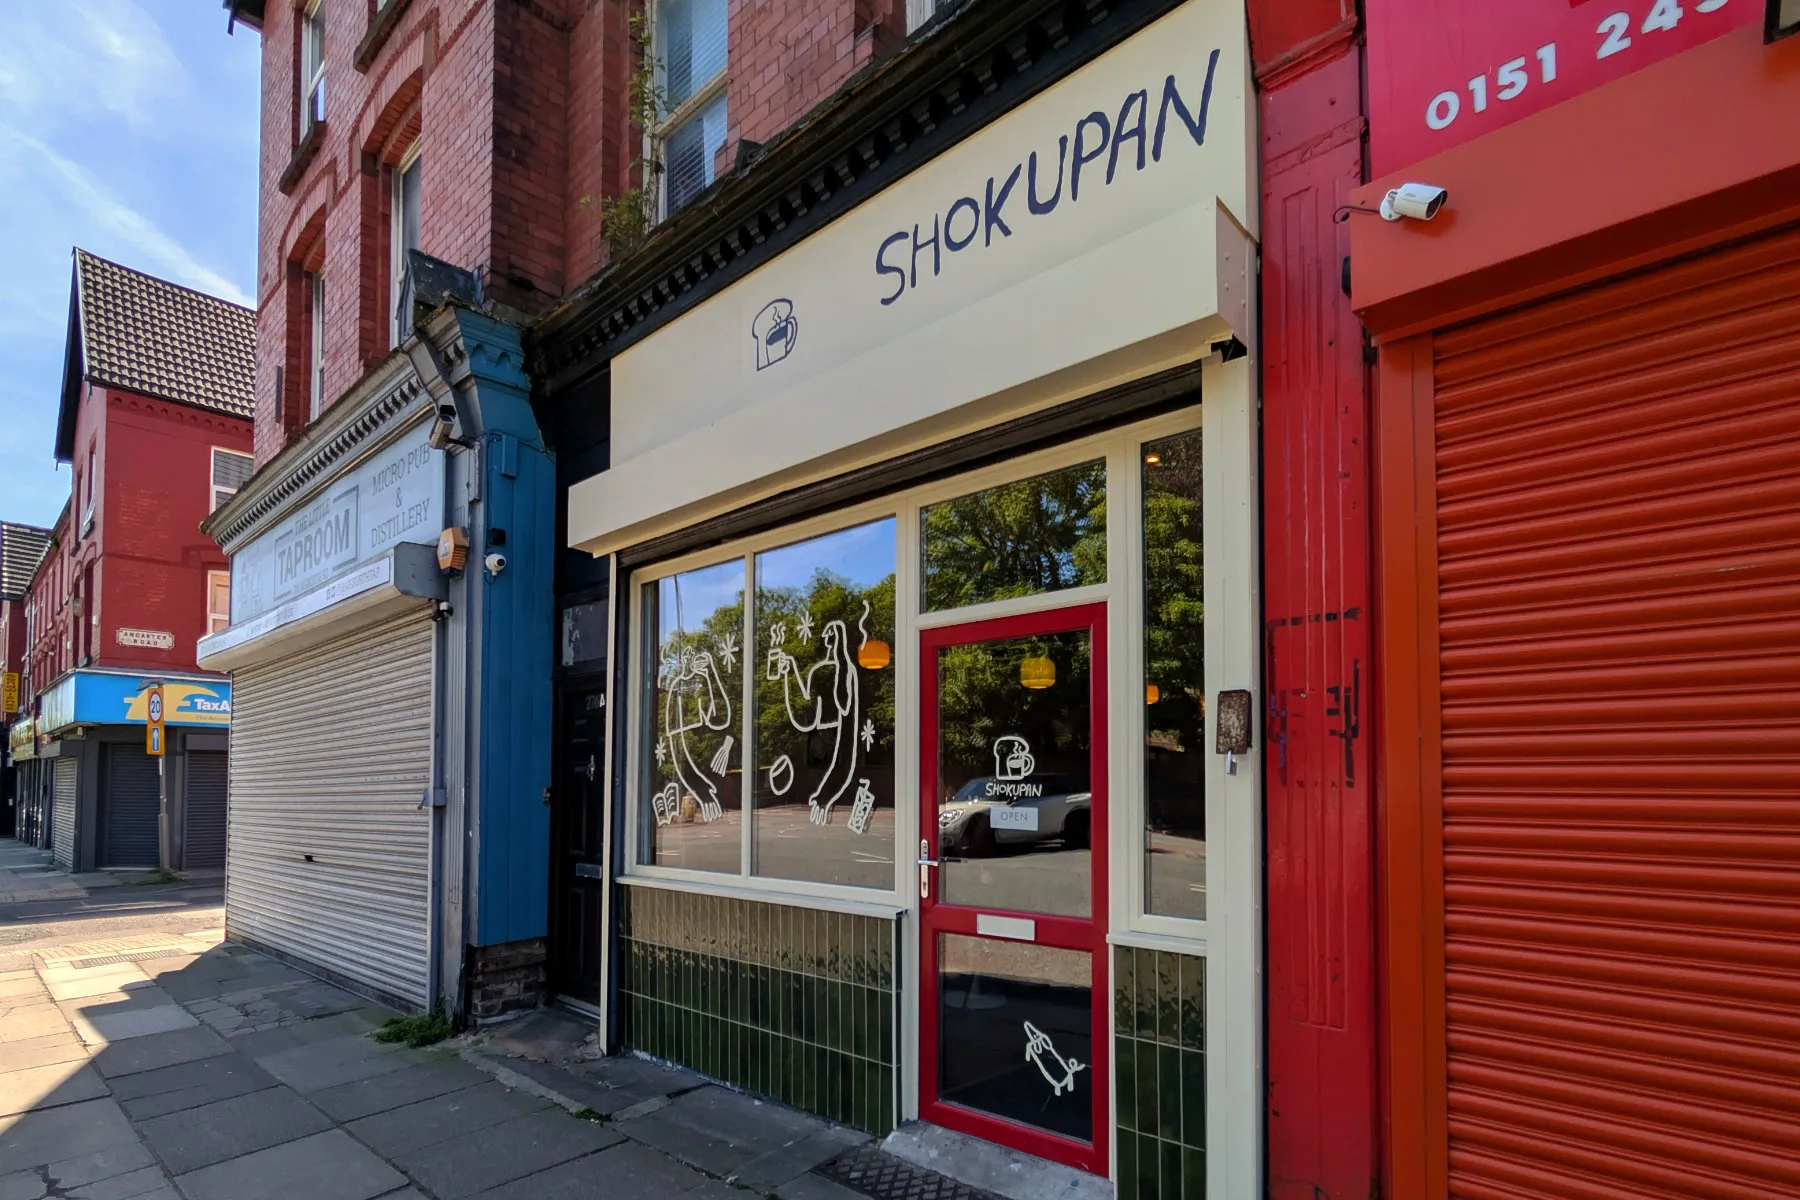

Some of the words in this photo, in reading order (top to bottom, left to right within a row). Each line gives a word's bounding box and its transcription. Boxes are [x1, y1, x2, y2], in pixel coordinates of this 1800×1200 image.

[1425, 42, 1557, 130] 0151
[876, 48, 1220, 305] SHOKUPAN
[371, 458, 406, 495] MICRO
[407, 442, 430, 474] PUB
[395, 487, 403, 508] &
[295, 514, 308, 536] THE
[309, 497, 331, 526] LITTLE
[371, 497, 430, 549] DISTILLERY
[278, 507, 350, 586] TAPROOM
[123, 631, 167, 641] ANCASTER
[133, 638, 158, 646] ROAD
[151, 700, 160, 713] 20
[585, 693, 605, 711] 276A
[985, 782, 1042, 797] SHOKUPAN
[1000, 811, 1028, 822] OPEN
